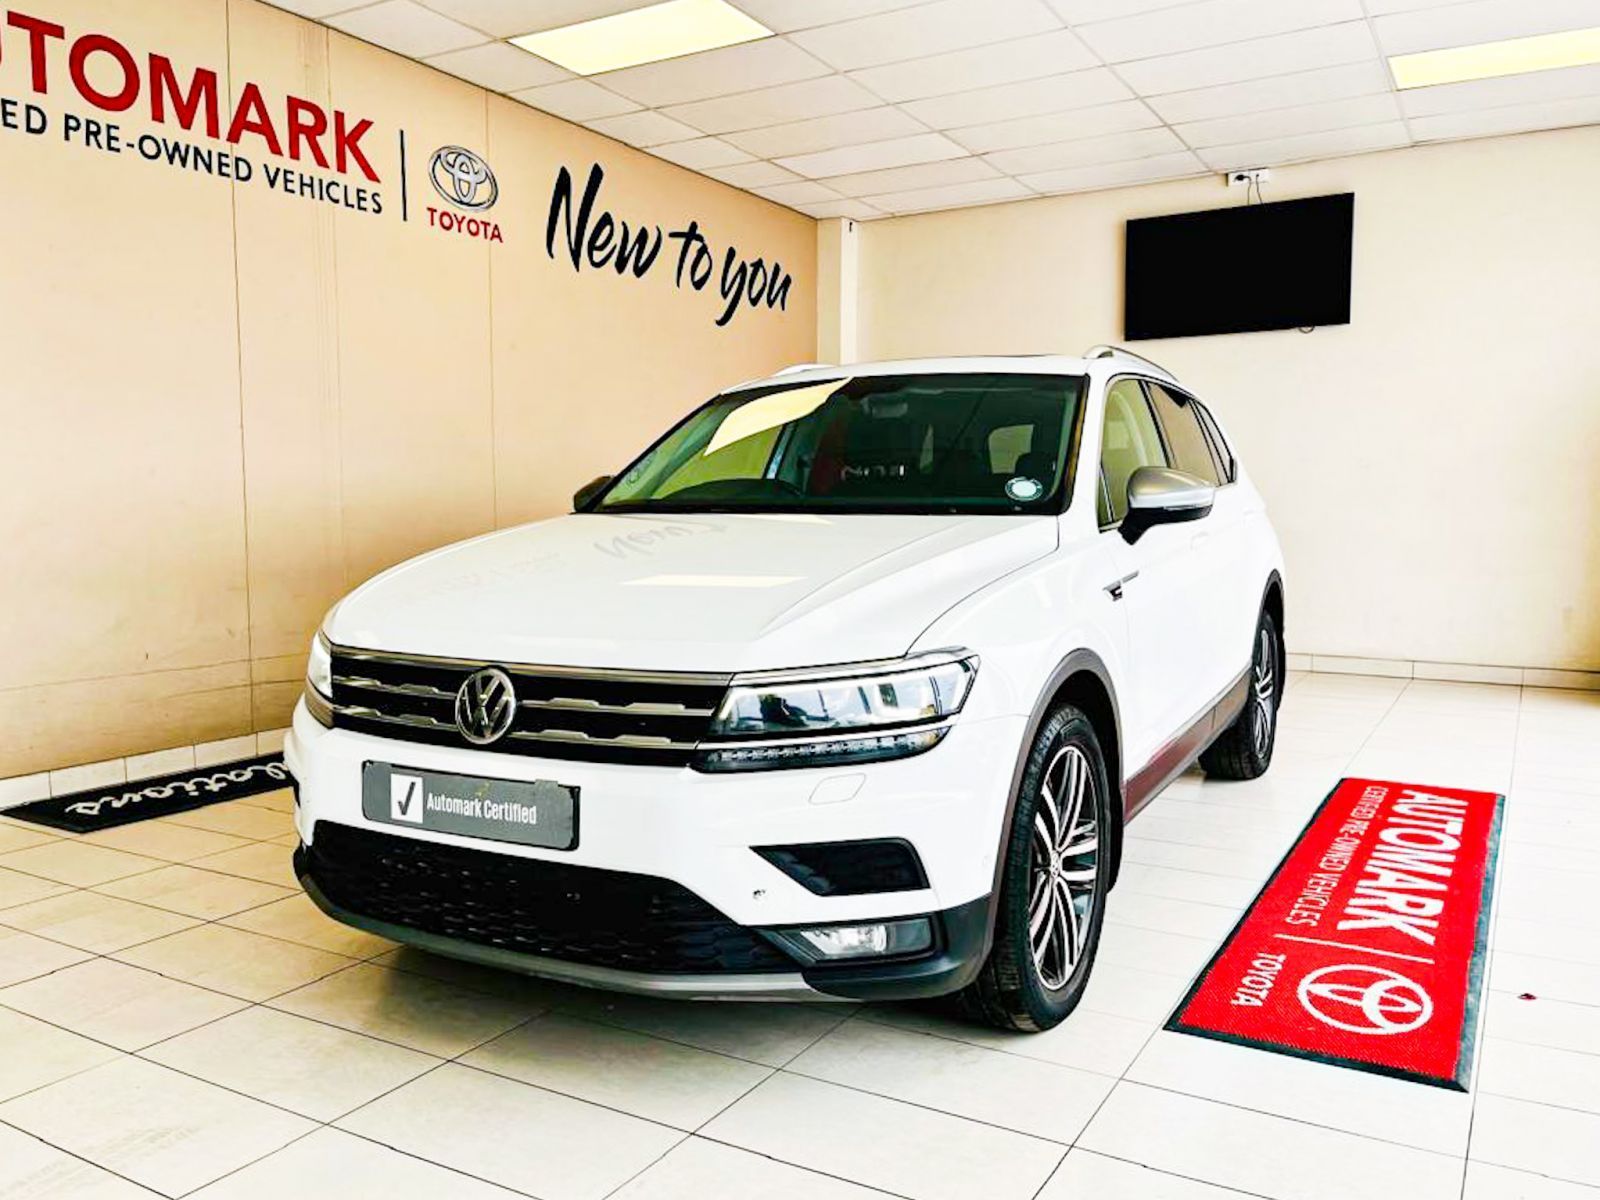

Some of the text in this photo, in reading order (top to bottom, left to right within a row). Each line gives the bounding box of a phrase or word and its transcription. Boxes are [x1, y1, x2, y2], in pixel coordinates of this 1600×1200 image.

[0, 10, 382, 185] TOMARK
[63, 112, 253, 182] PRE-OWNED
[263, 162, 383, 214] VEHICLES
[426, 206, 504, 243] TOYOTA
[546, 162, 792, 327] New to you
[426, 792, 538, 825] Automark Certified
[1285, 785, 1389, 927] CERTIFIED PRE-OWNED VEHICLES
[1336, 789, 1469, 946] AUTOMARK
[1230, 951, 1286, 1007] TOYOTA
